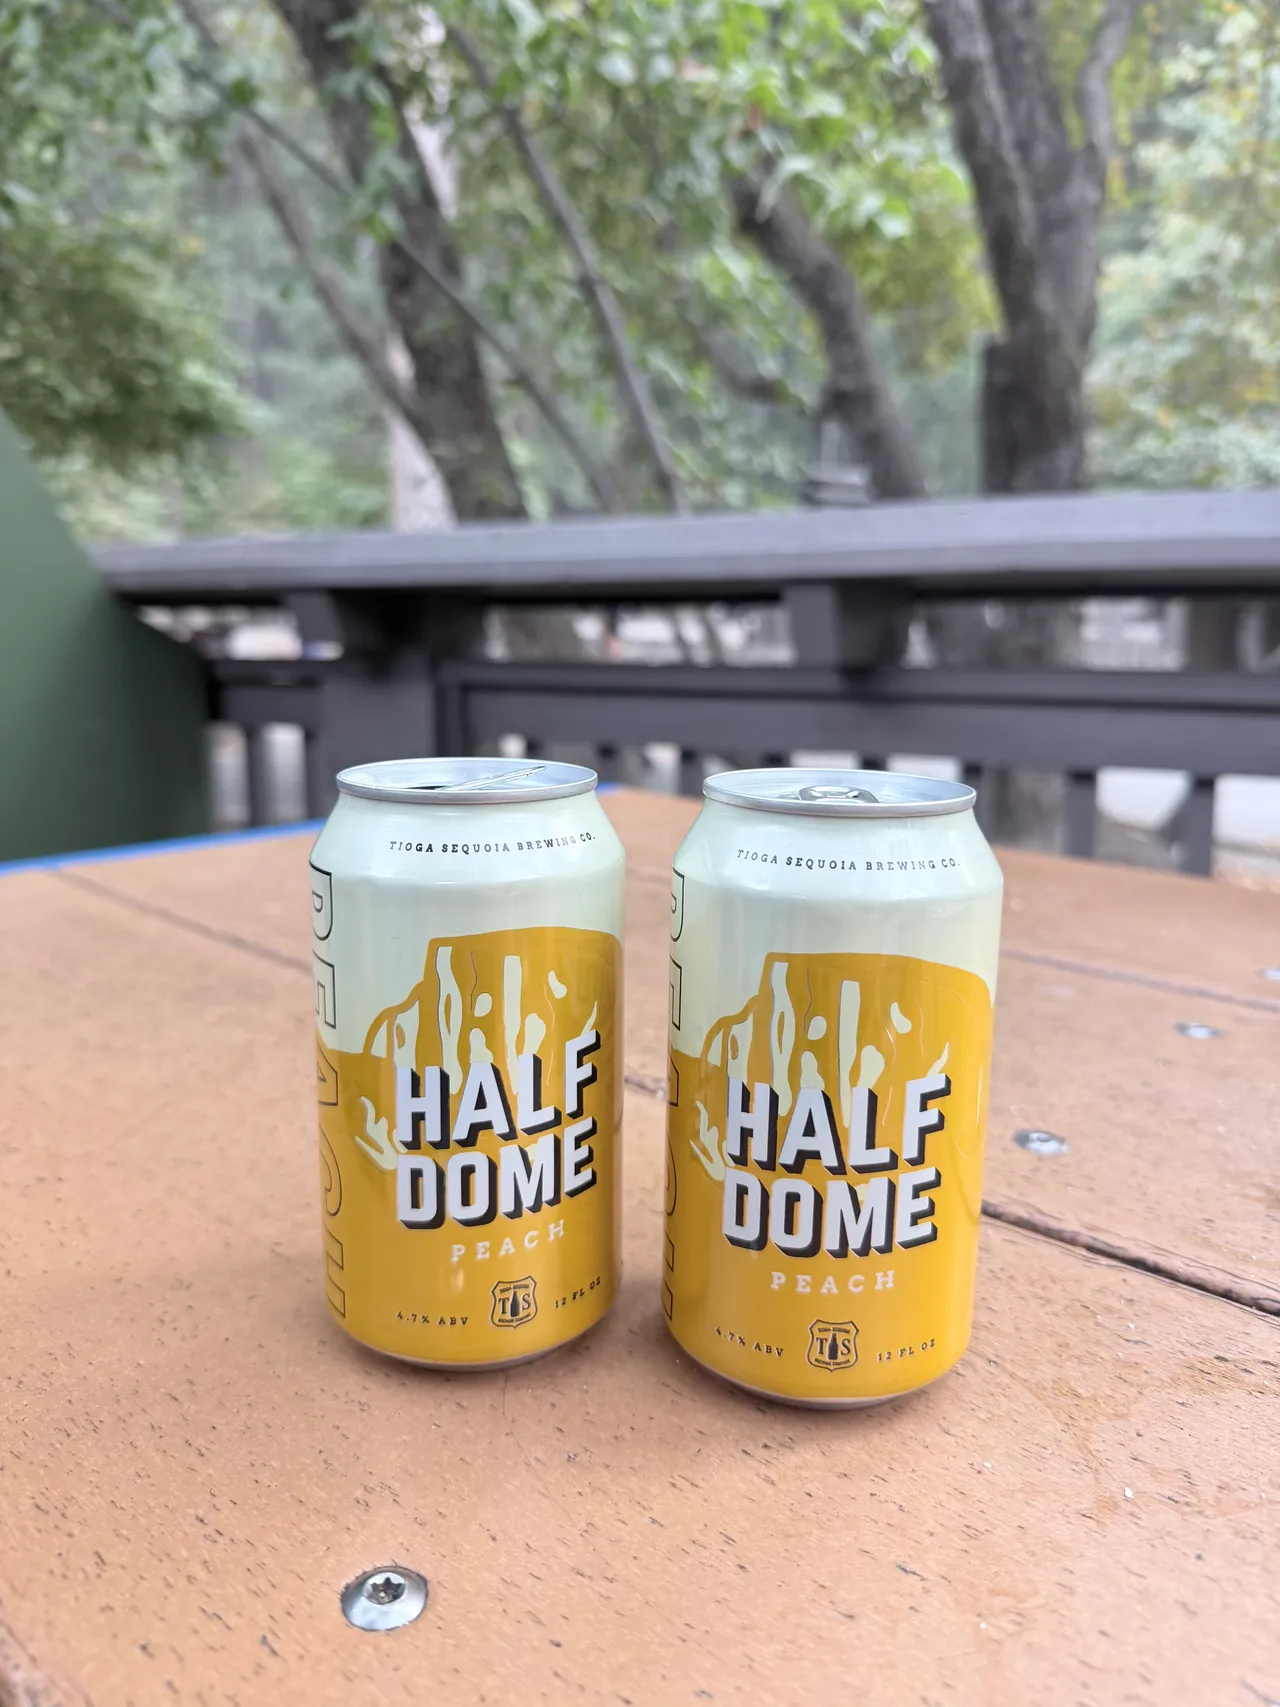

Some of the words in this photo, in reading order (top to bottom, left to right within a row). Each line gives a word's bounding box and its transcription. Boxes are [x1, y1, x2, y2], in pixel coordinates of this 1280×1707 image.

[389, 840, 434, 853] TIOGA
[441, 842, 510, 855] SEQUOIA
[517, 835, 577, 851] BREWING
[579, 832, 596, 842] CO.
[736, 849, 778, 864] TIOGA
[785, 856, 857, 870] SEQUOIA
[865, 860, 937, 871] BREWING
[941, 857, 961, 867] CO.
[395, 1029, 602, 1150] HALF
[726, 1073, 951, 1176] HALF
[396, 1116, 598, 1230] DOME
[722, 1166, 942, 1259] DOME
[450, 1219, 565, 1264] PEACH
[553, 1296, 568, 1309] 12
[571, 1287, 586, 1301] FL
[589, 1275, 601, 1290] OZ
[770, 1269, 896, 1294] PEACH
[395, 1310, 431, 1325] 4.7%
[437, 1316, 469, 1326] ABV
[714, 1326, 747, 1346] 4.7%
[753, 1341, 784, 1356] ABV
[876, 1351, 892, 1361] 12
[897, 1346, 915, 1358] FL
[920, 1338, 936, 1351] OZ
